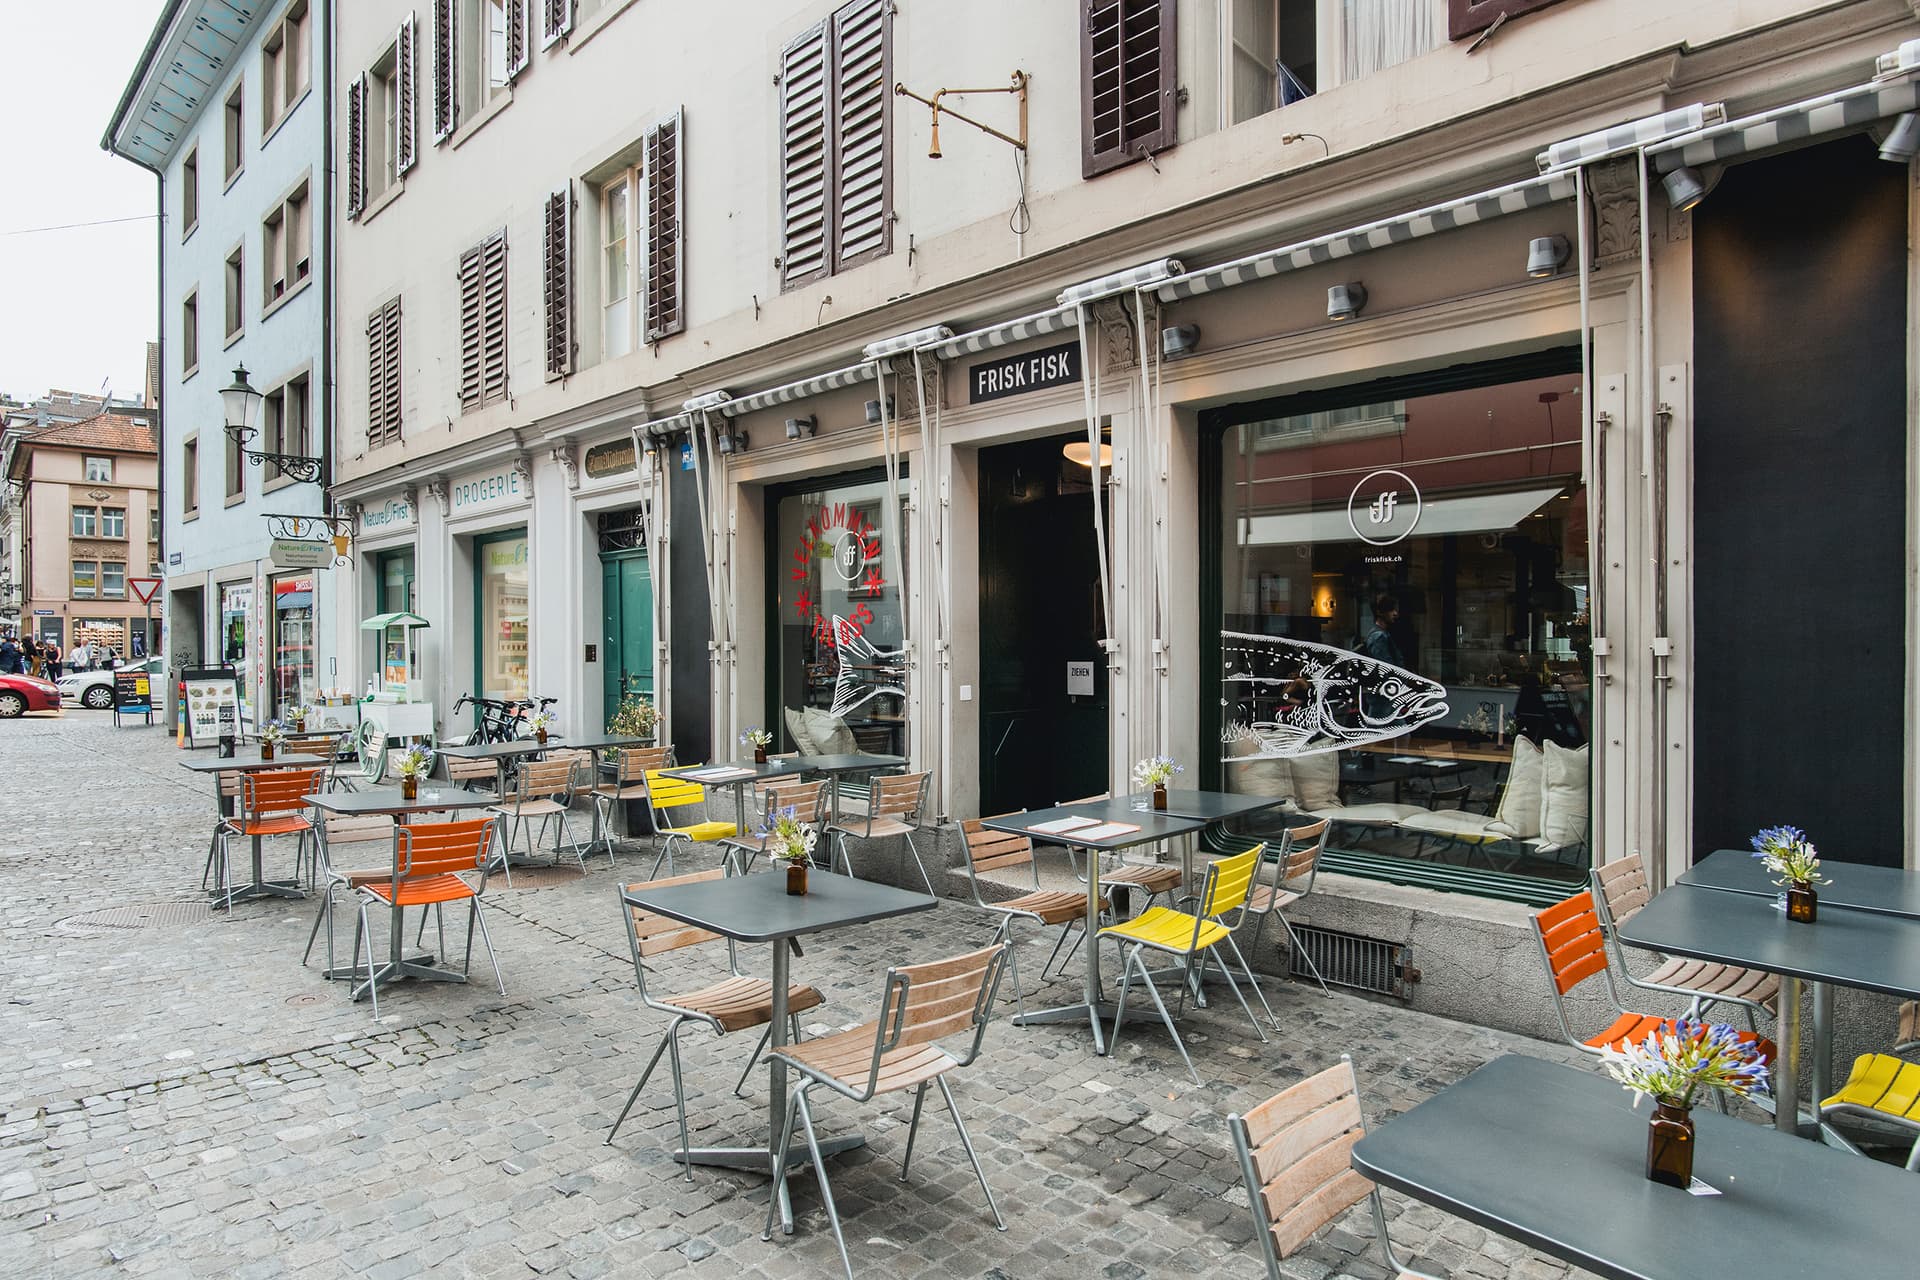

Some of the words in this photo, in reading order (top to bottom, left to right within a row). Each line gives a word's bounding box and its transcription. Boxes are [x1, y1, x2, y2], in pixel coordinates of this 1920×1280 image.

[979, 361, 1026, 395] FRISK
[1030, 351, 1070, 384] FISK
[456, 472, 519, 507] DROGERIE
[363, 511, 385, 528] Nature
[392, 502, 409, 520] First
[278, 544, 301, 552] Nature
[791, 502, 881, 582] VELKOMMEN
[1364, 555, 1402, 564] friskfisk.ch
[1071, 667, 1090, 677] ZIEHEN
